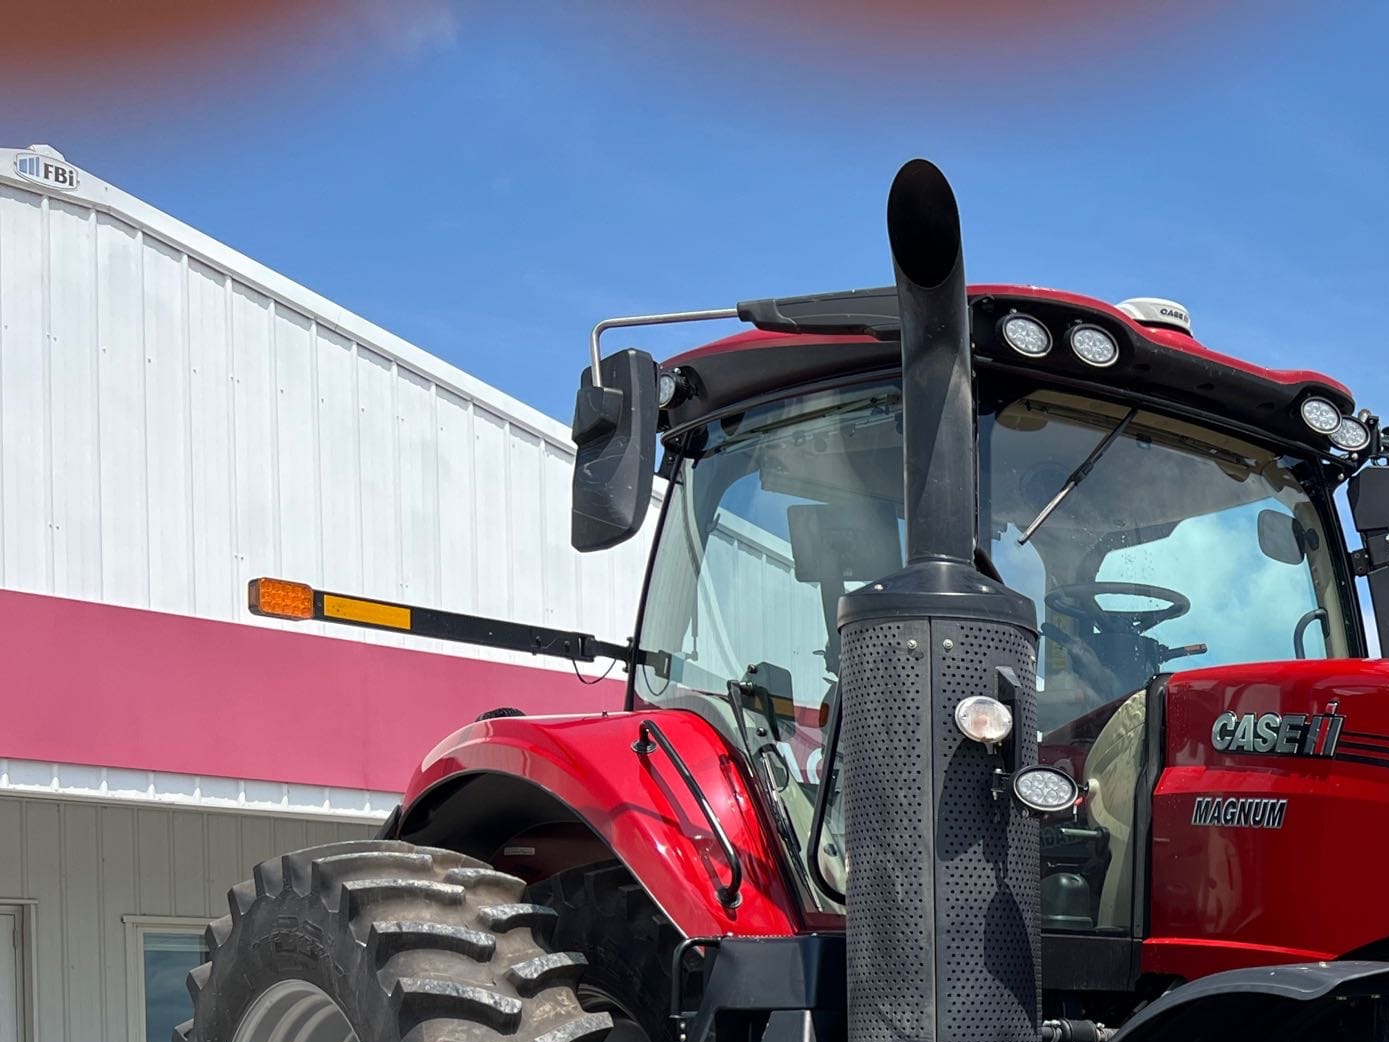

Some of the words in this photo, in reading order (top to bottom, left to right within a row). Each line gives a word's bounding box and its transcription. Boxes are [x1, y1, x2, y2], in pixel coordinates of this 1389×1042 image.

[1159, 307, 1183, 321] CASE
[1210, 710, 1307, 755] CASE
[1191, 797, 1289, 829] MAGNUM
